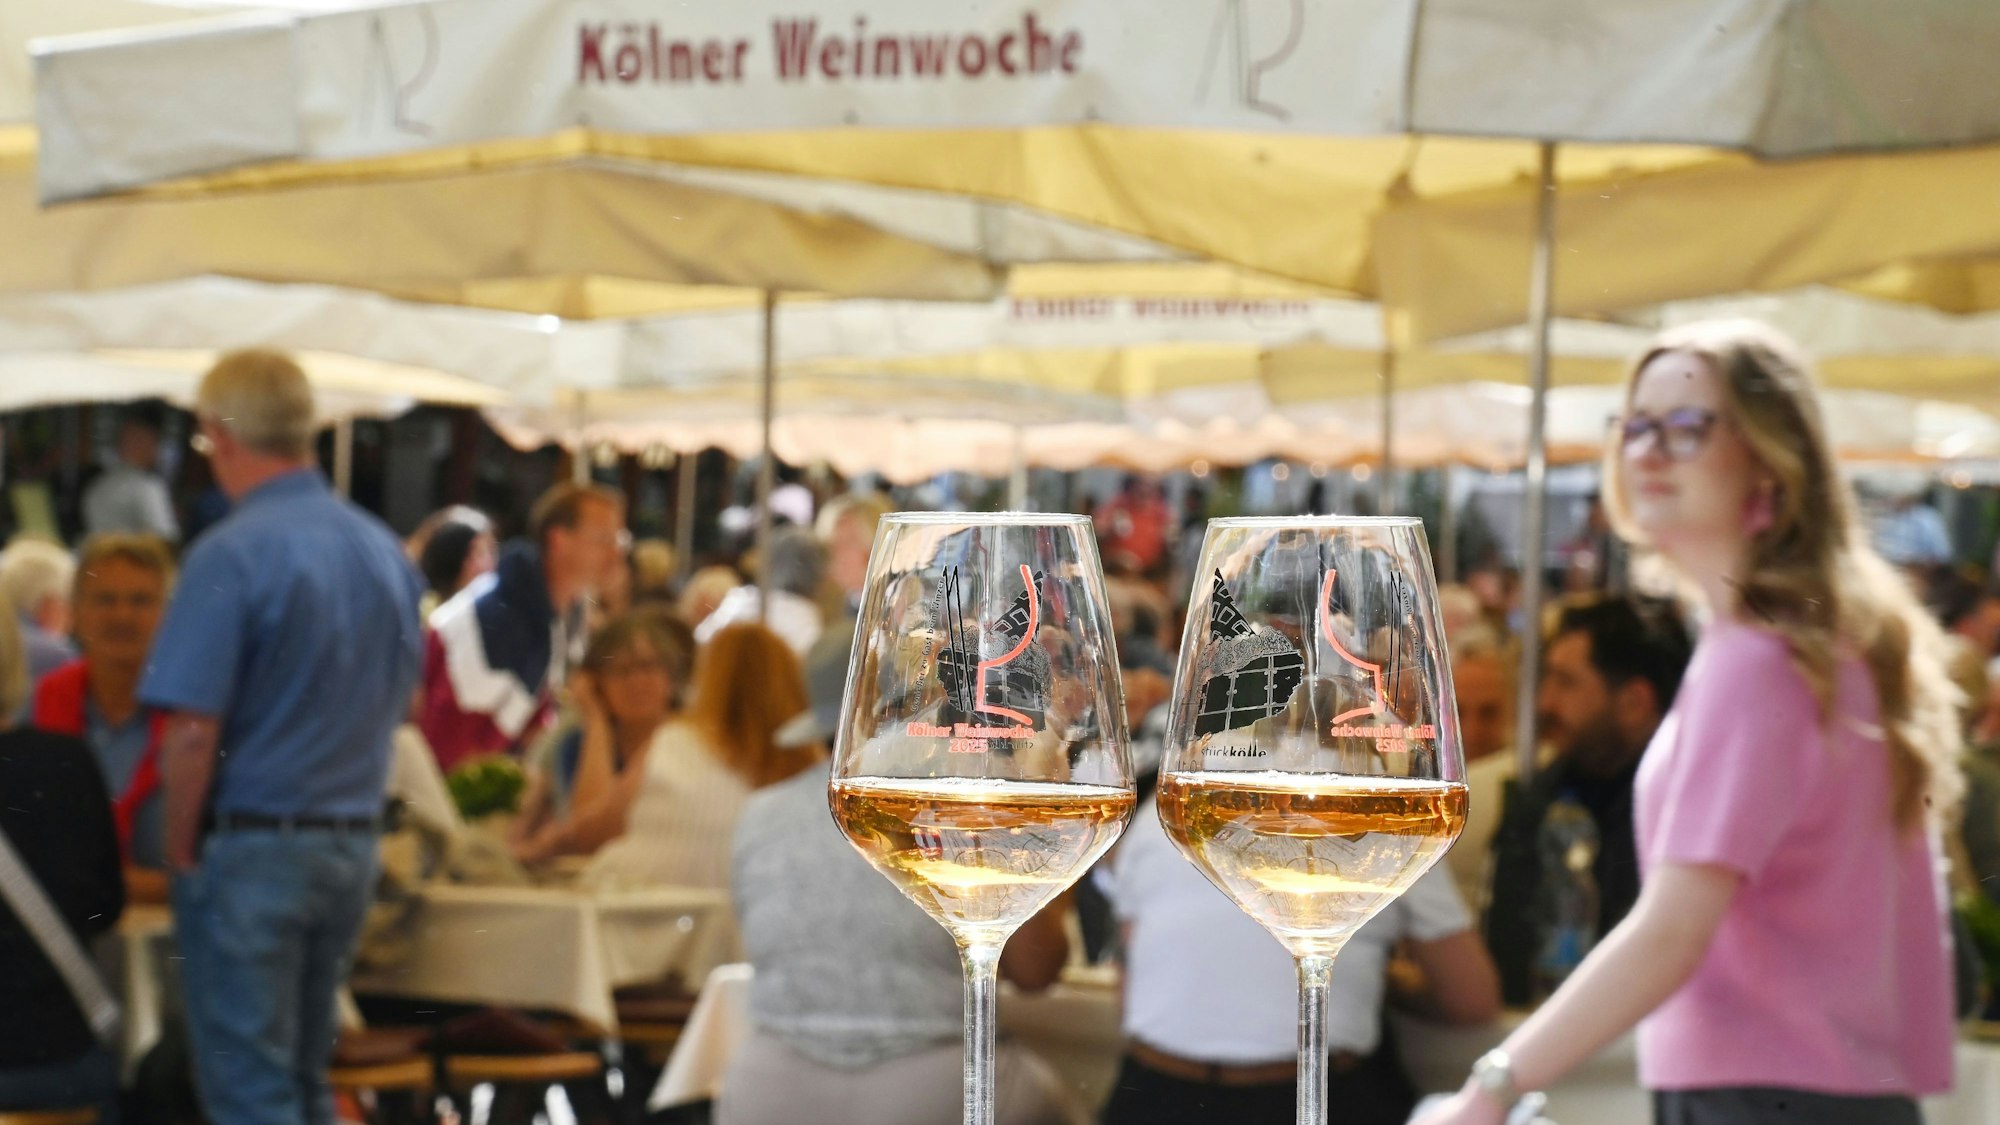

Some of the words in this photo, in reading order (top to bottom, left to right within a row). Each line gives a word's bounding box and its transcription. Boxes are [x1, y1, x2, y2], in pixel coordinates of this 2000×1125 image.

[578, 21, 750, 85] Kölner
[772, 12, 1082, 81] Weinwoche
[907, 722, 952, 737] Kölner
[954, 723, 1035, 738] Weinwoche
[949, 739, 988, 753] 2025
